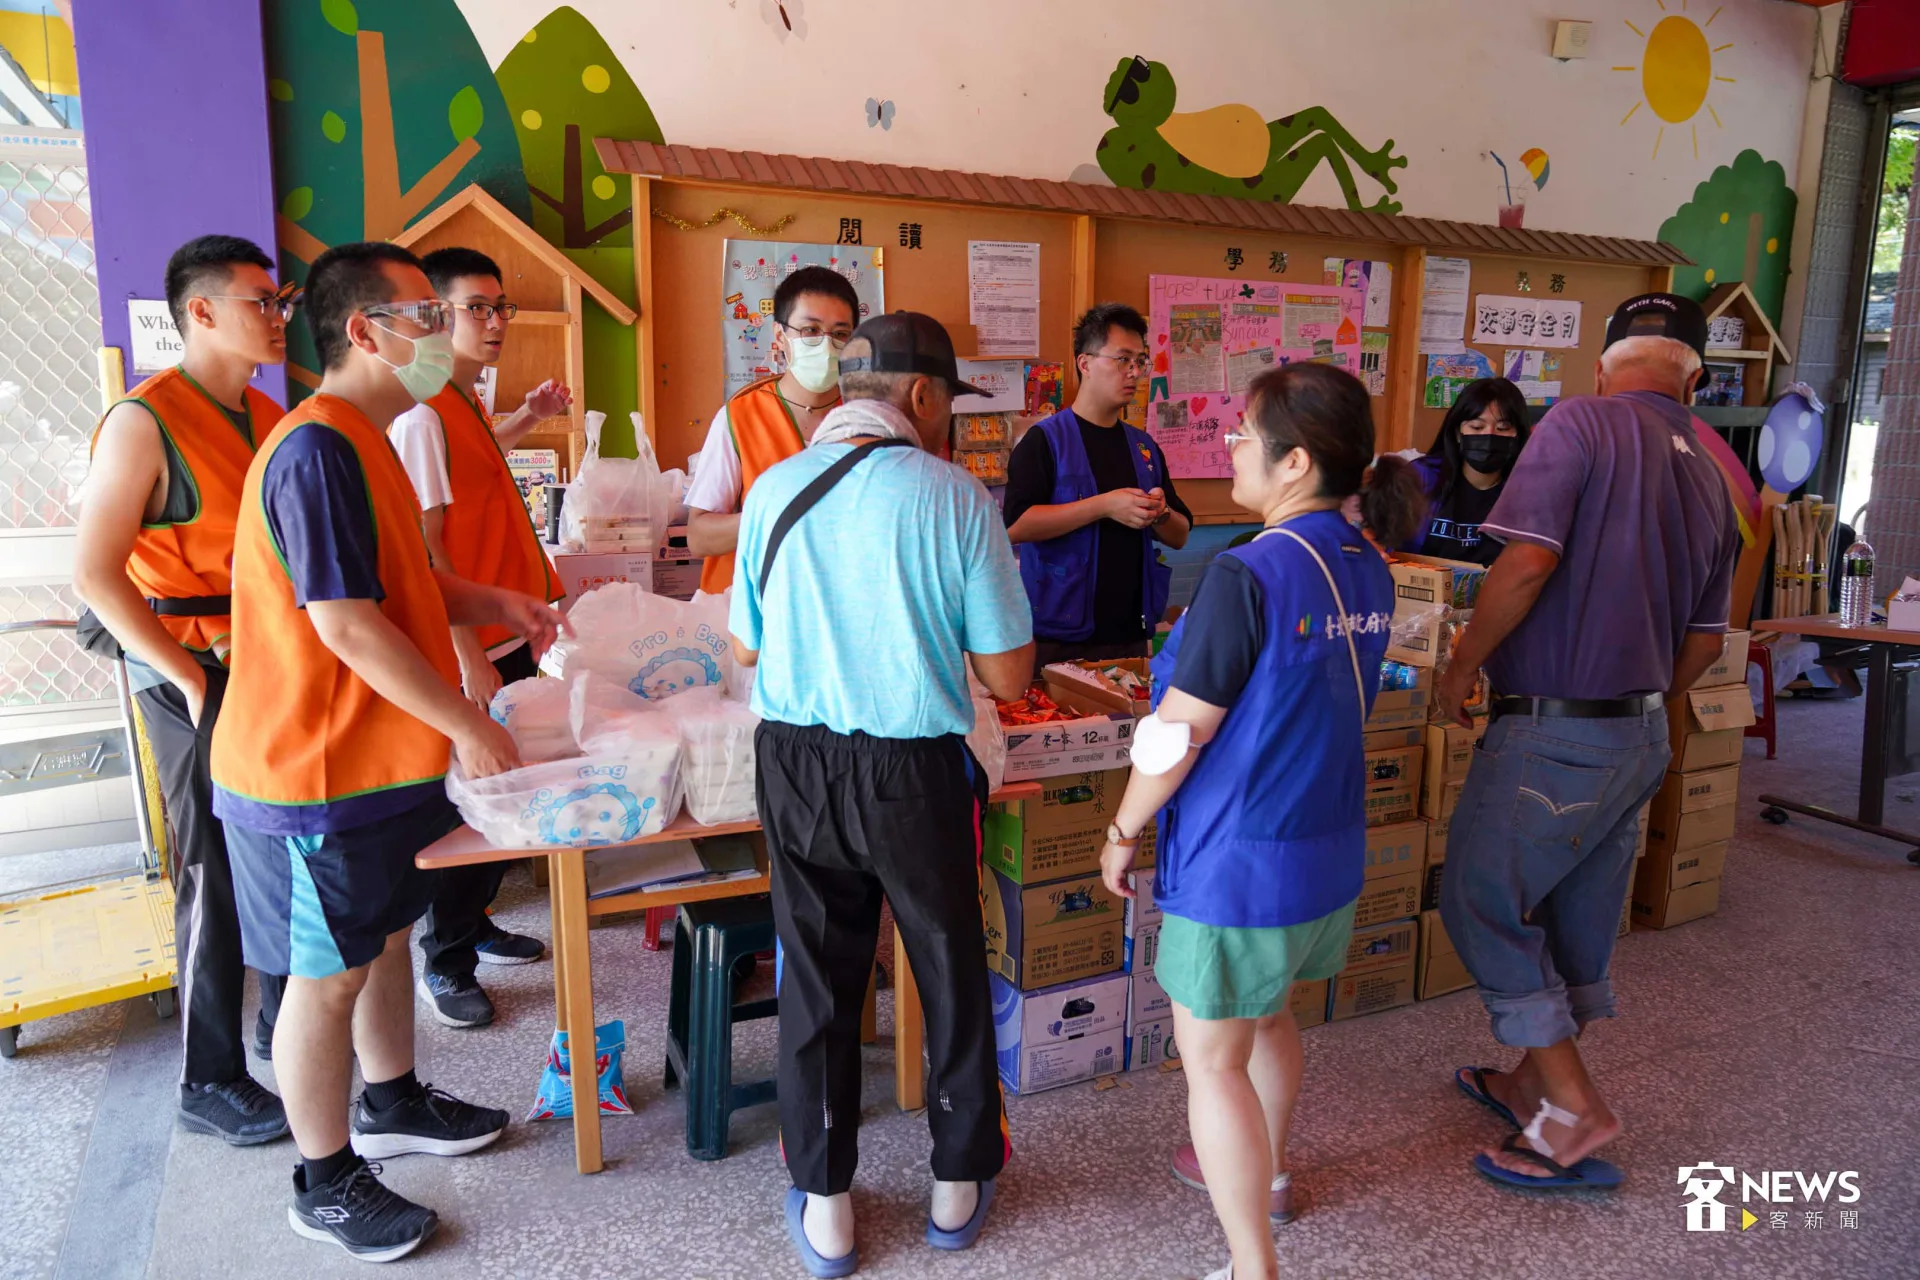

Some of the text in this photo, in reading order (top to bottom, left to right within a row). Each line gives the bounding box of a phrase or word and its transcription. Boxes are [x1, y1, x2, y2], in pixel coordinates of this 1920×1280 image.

[836, 217, 922, 250] 閱讀
[1223, 247, 1288, 274] 學務
[1479, 306, 1576, 340] 交通安全月
[155, 336, 183, 351] the
[628, 631, 668, 659] Pro
[695, 623, 728, 656] Bag
